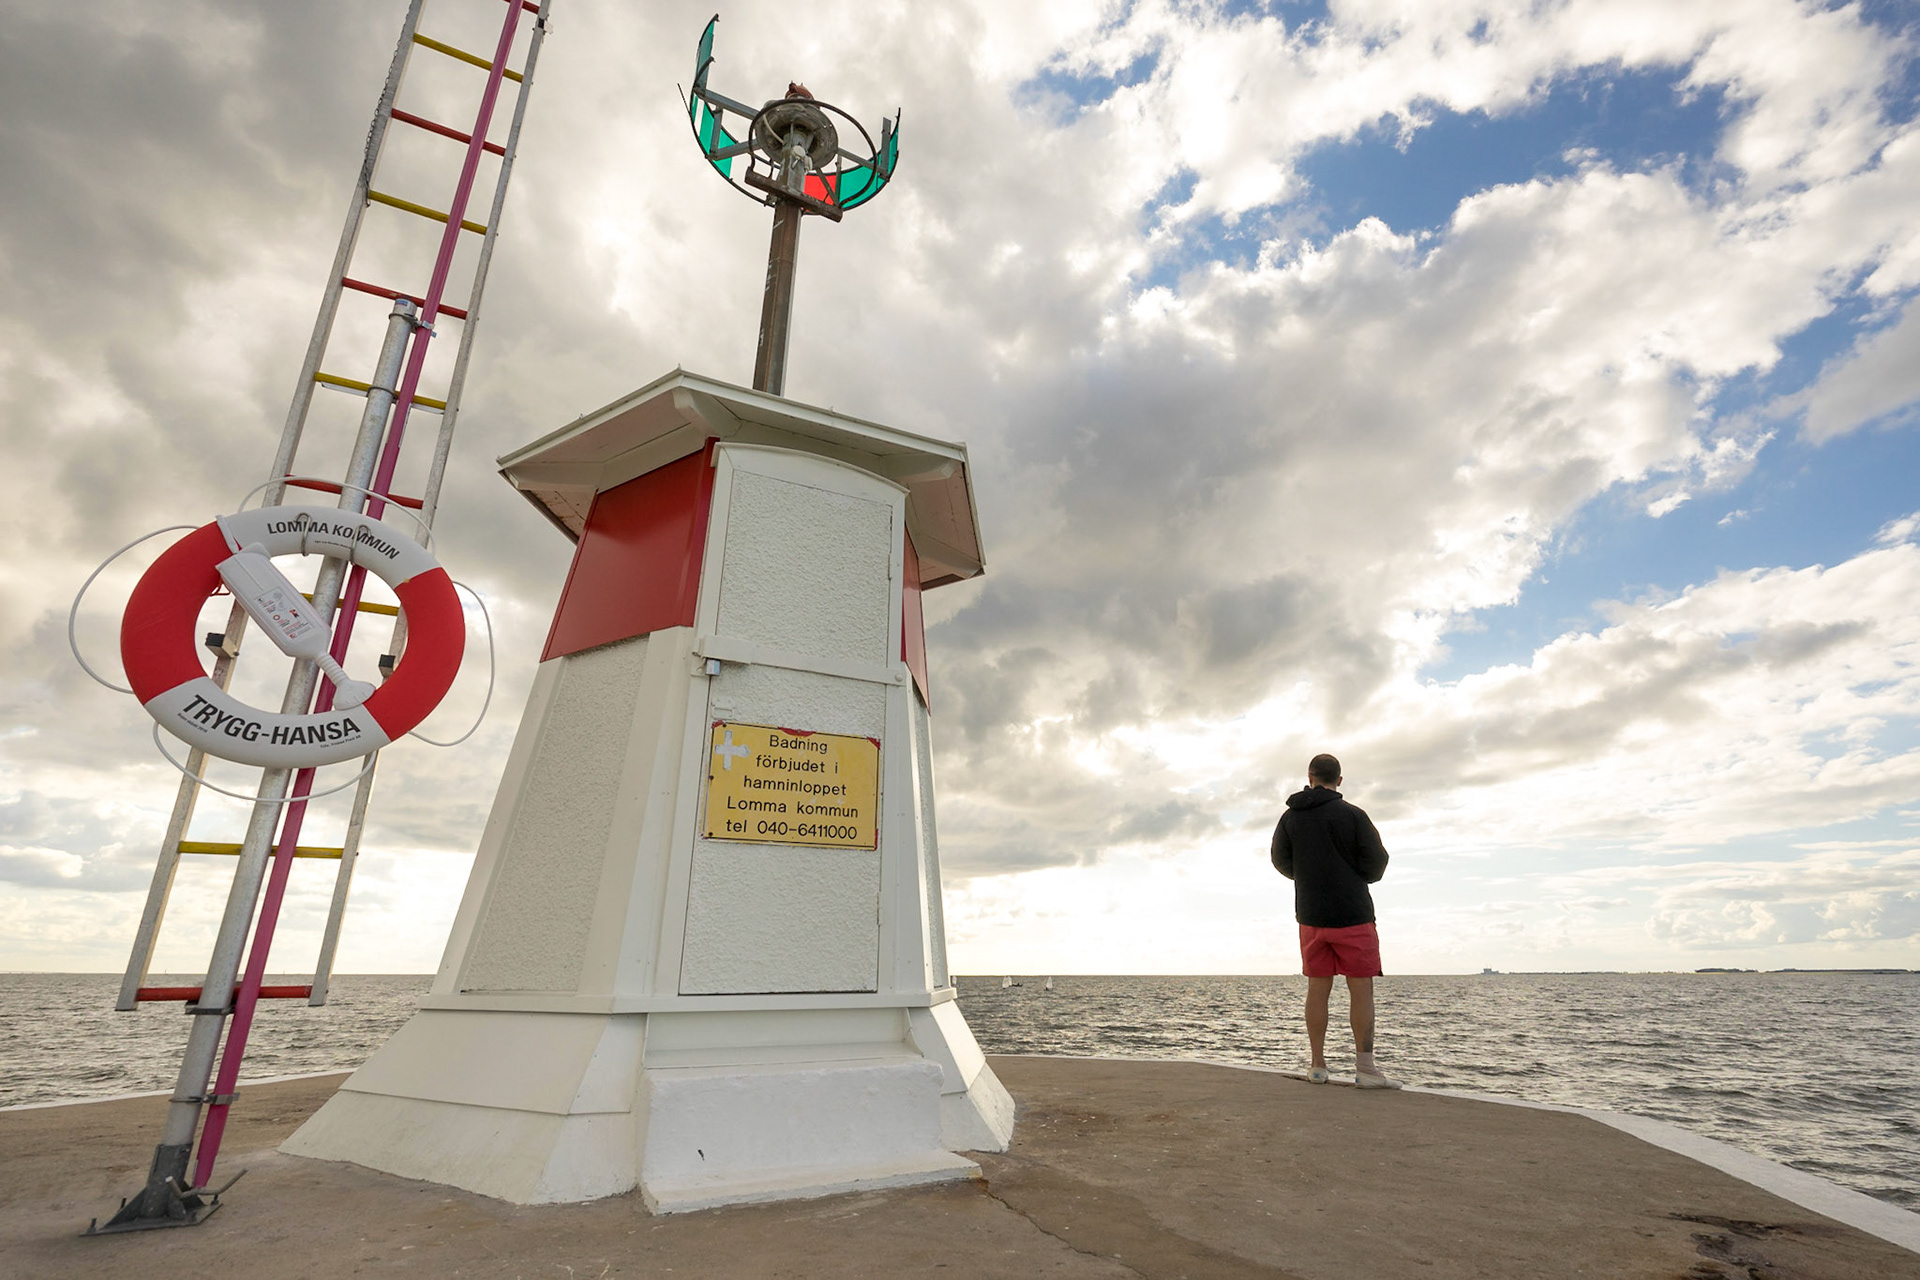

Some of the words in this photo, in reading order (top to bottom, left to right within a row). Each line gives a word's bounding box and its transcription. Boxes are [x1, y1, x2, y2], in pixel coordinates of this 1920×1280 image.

[267, 521, 329, 534] LOMMA
[332, 524, 400, 560] KOMMUN
[182, 694, 362, 746] TRYGG-HANSA
[769, 734, 828, 754] Badning
[756, 754, 825, 773] förbjudet
[834, 762, 838, 774] i
[743, 775, 847, 796] hamninloppet
[727, 796, 787, 813] Lomma
[797, 801, 859, 818] kommun
[726, 819, 747, 833] tel
[757, 820, 857, 840] 040-6411000
